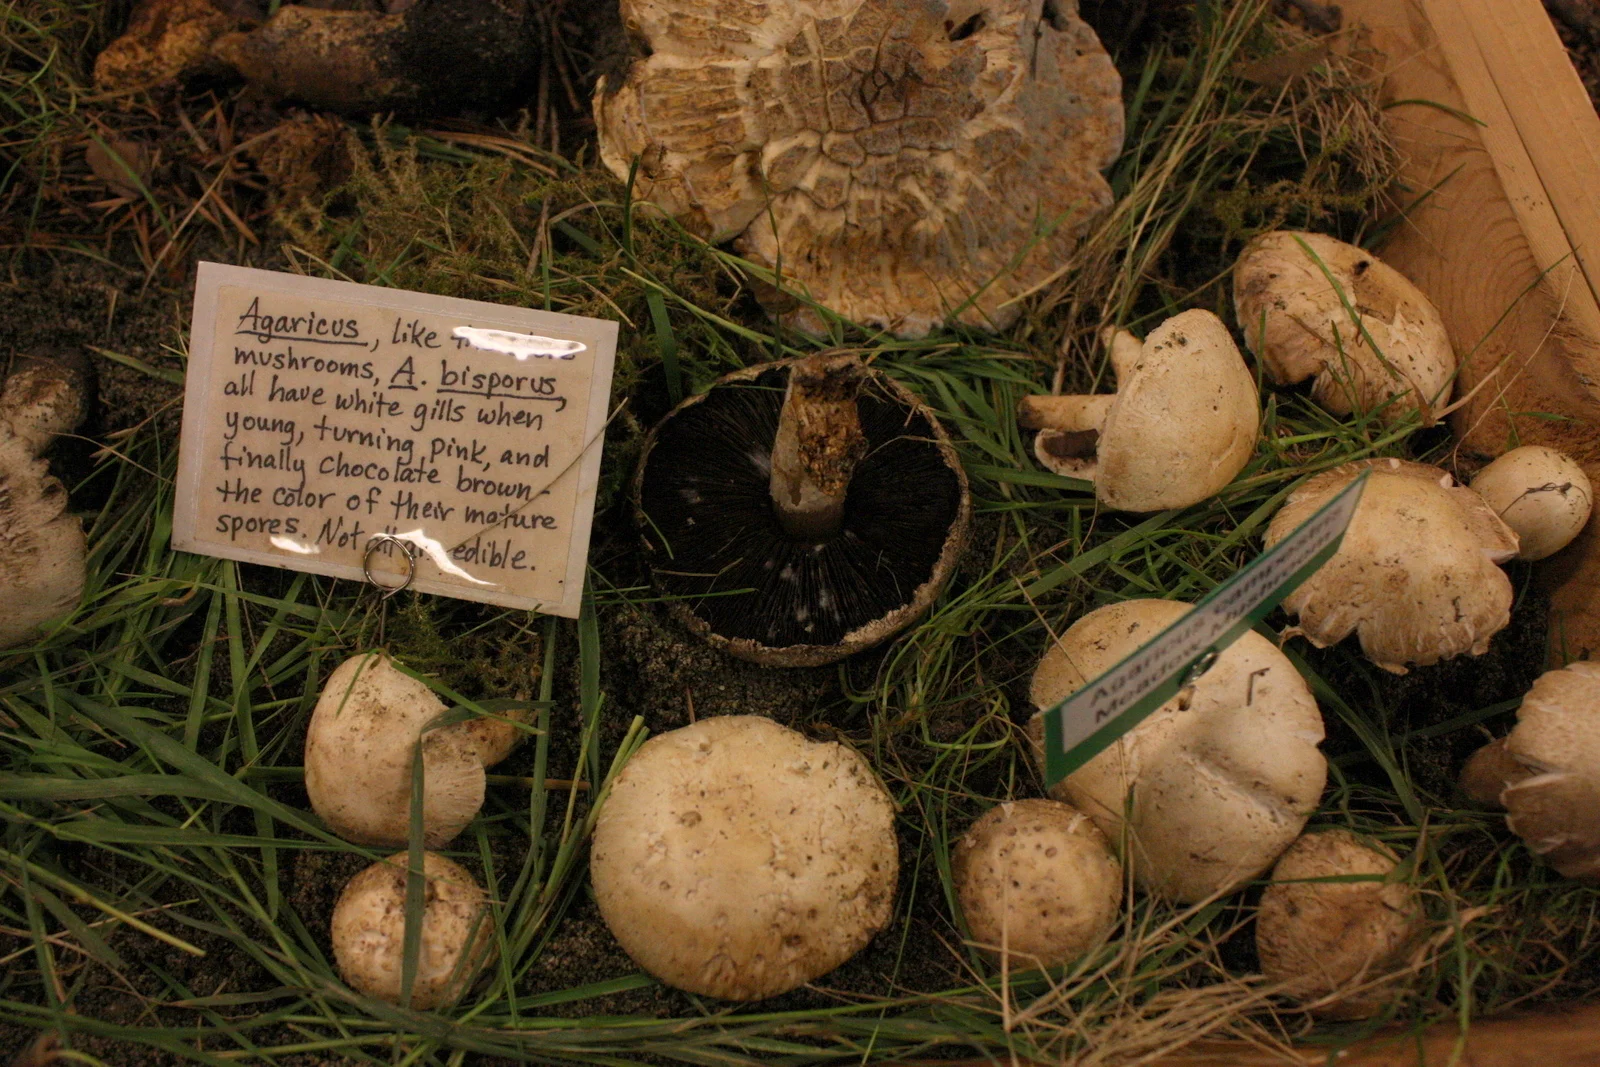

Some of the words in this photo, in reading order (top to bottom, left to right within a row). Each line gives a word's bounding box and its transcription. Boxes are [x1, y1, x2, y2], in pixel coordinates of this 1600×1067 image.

[235, 297, 379, 352] Agaricus,
[392, 317, 441, 349] like
[224, 370, 255, 396] all
[269, 374, 326, 405] have
[336, 388, 403, 417] white
[411, 398, 465, 431] gills
[478, 401, 543, 431] when
[234, 346, 379, 386] mushrooms,
[388, 355, 427, 391] A.
[437, 359, 567, 412] bisporus,
[220, 441, 306, 484] finally
[319, 451, 441, 483] chocolate
[224, 411, 304, 447] young,
[314, 415, 414, 466] turning
[430, 437, 491, 471] pink,
[500, 444, 550, 468] and
[216, 478, 261, 504] the
[273, 484, 335, 509] color
[347, 487, 381, 514] of
[390, 490, 454, 521] their
[465, 503, 557, 530] mature
[216, 514, 307, 541] spores.
[315, 516, 365, 550] Not
[366, 525, 397, 557] all
[453, 537, 536, 571] edible.
